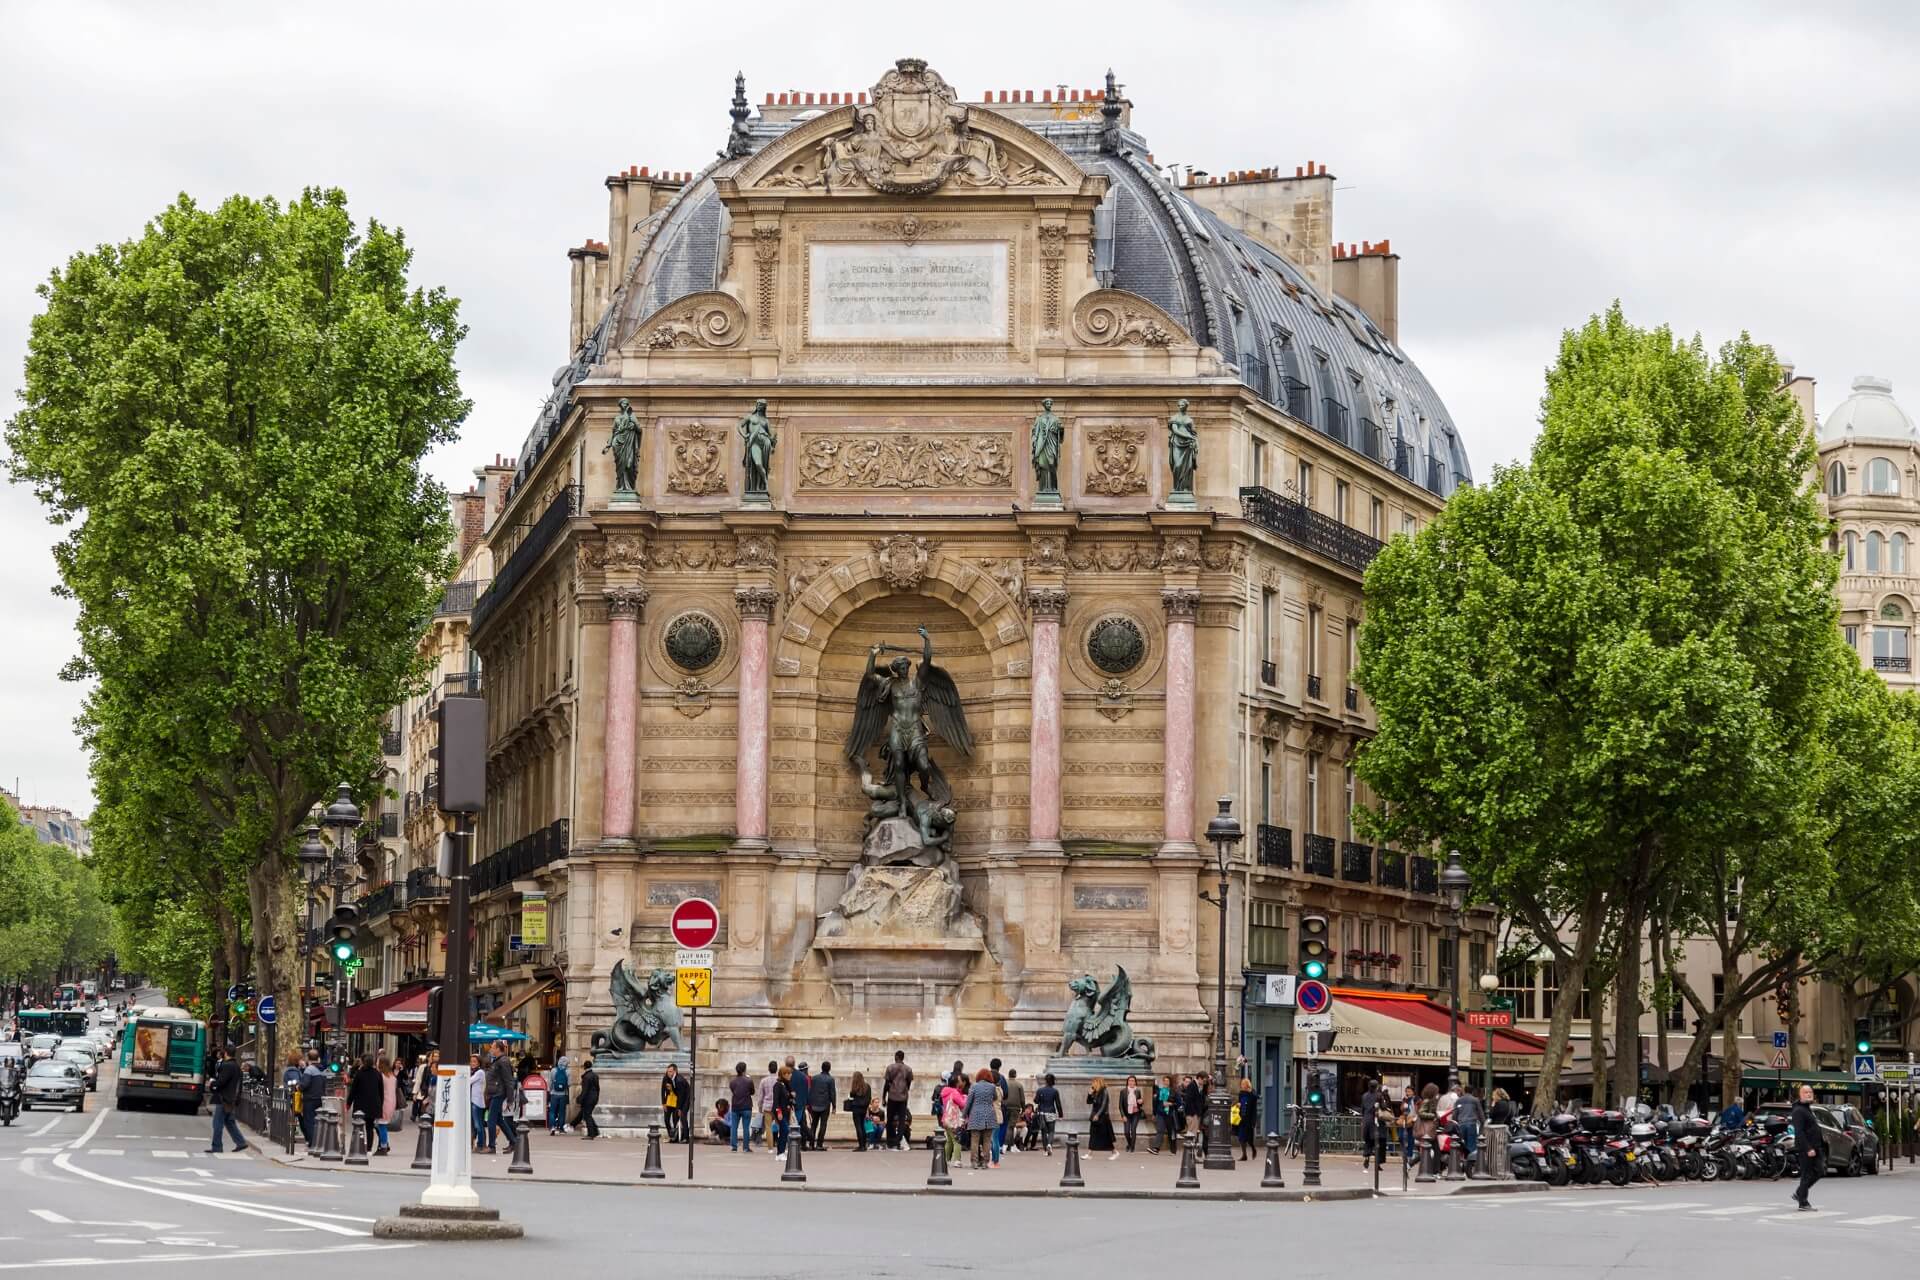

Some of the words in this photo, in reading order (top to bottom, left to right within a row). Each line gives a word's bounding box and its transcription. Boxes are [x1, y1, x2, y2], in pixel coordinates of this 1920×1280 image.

[1469, 1014, 1508, 1025] METRO
[1332, 1025, 1360, 1035] SERIE
[1330, 1044, 1377, 1055] ONTAINE
[1380, 1047, 1411, 1057] SAINT
[1413, 1049, 1451, 1058] MICHEL
